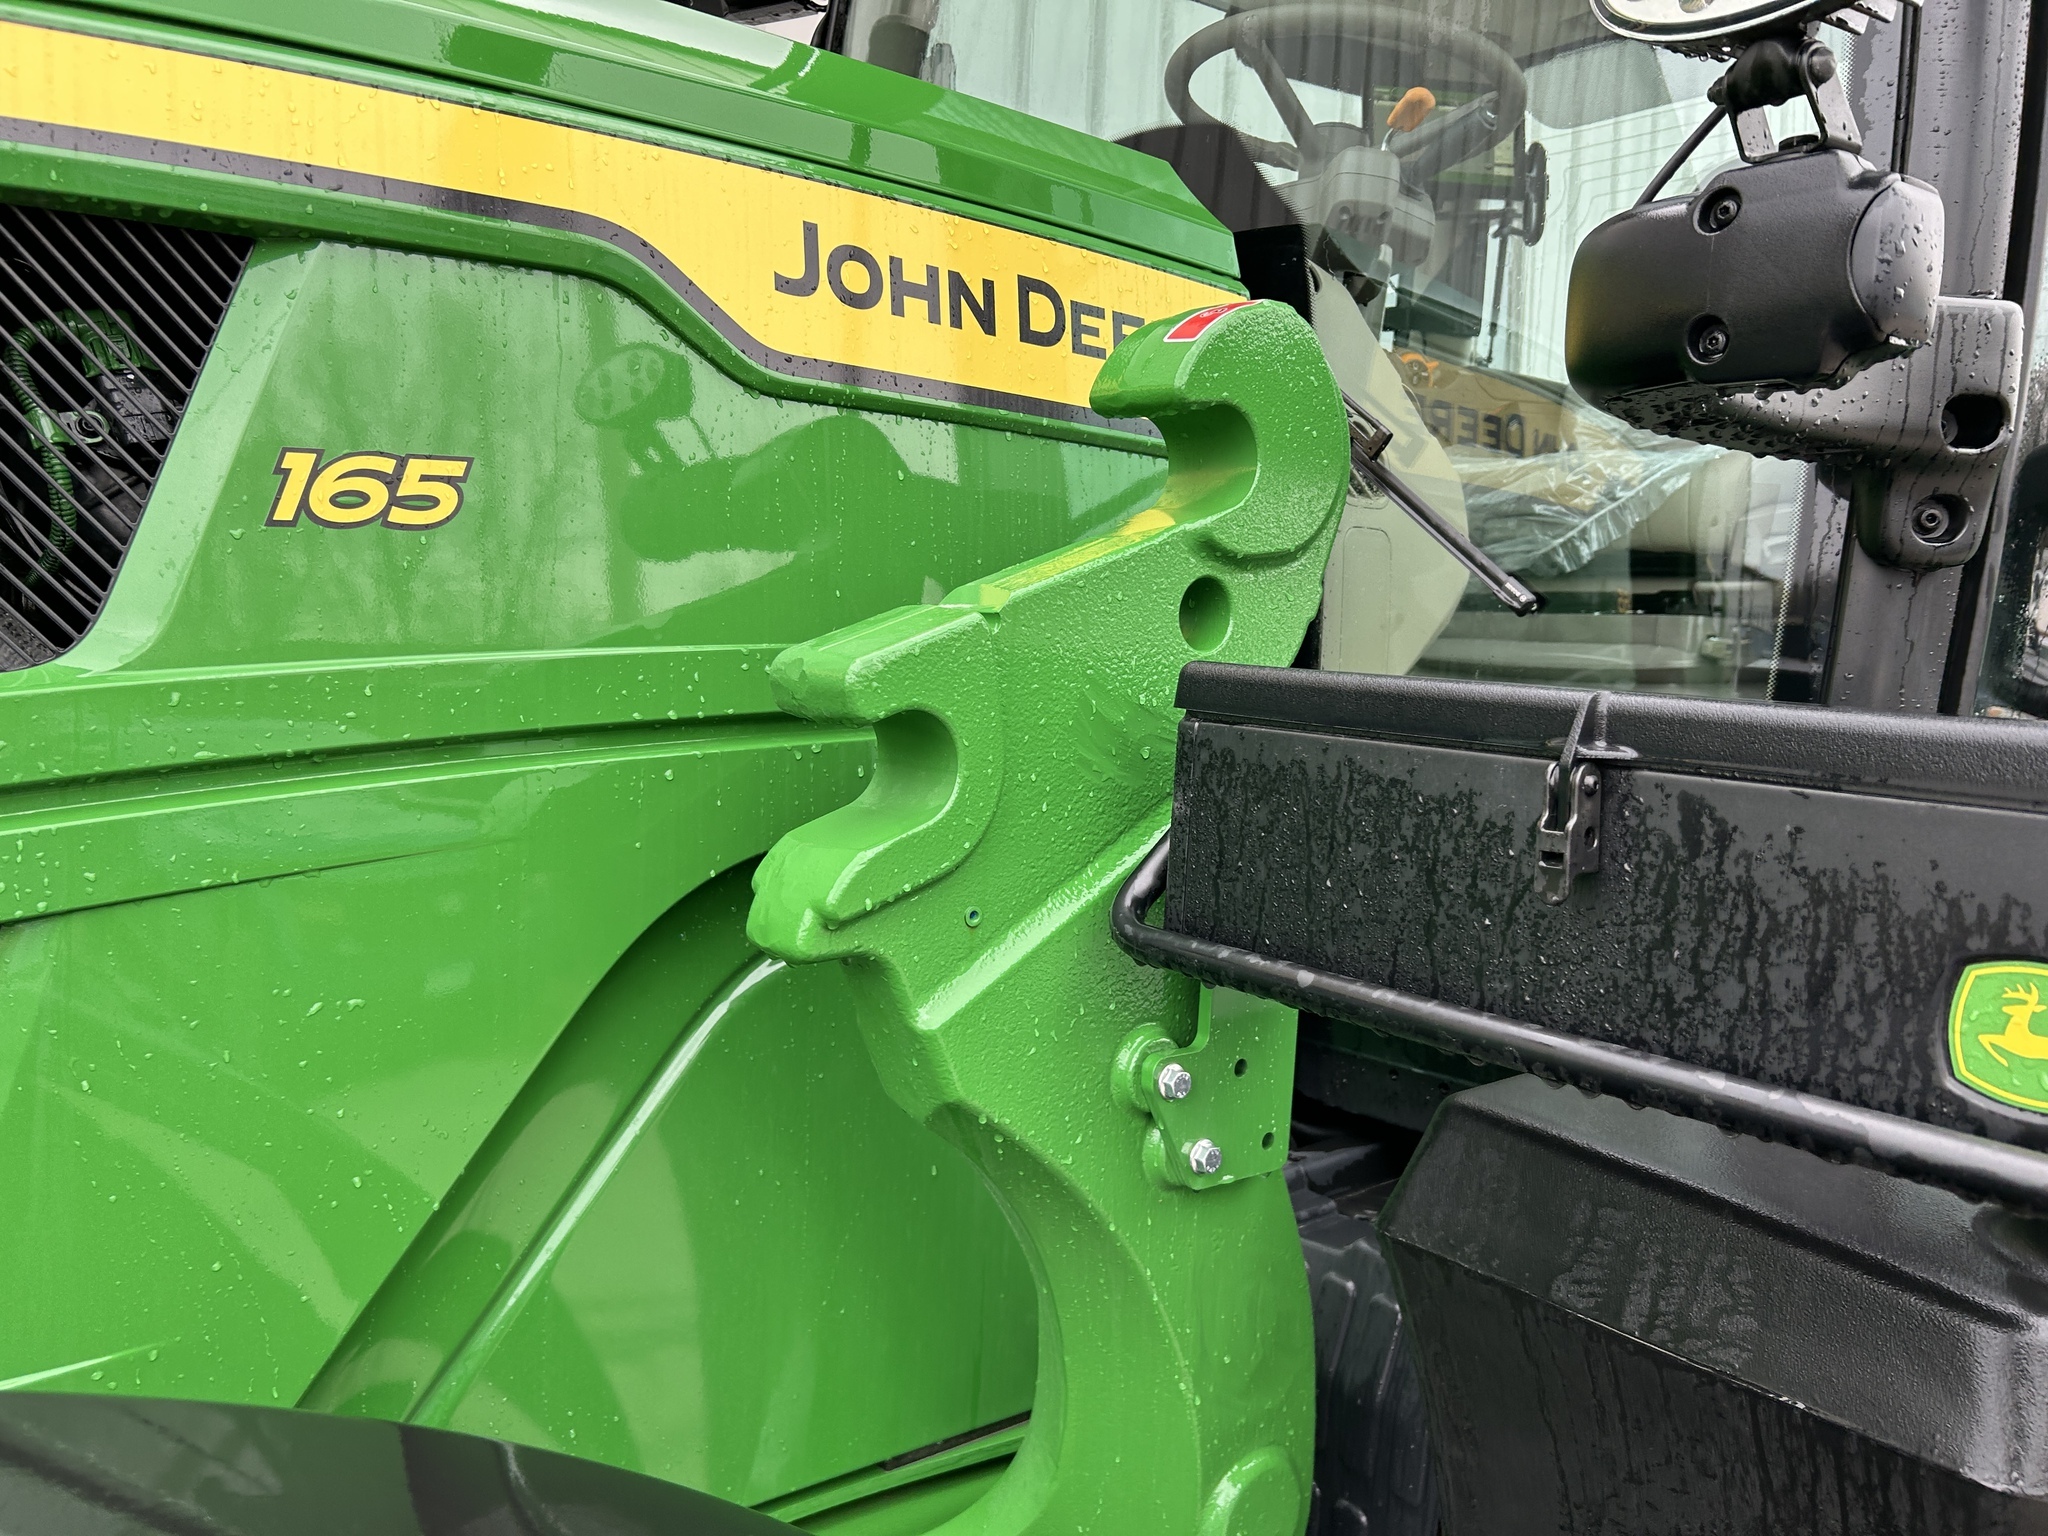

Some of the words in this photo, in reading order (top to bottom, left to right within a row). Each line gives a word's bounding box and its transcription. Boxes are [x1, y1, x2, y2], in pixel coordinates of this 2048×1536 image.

[774, 220, 996, 337] JOHN
[1017, 274, 1146, 360] DEE
[265, 447, 475, 531] 165
